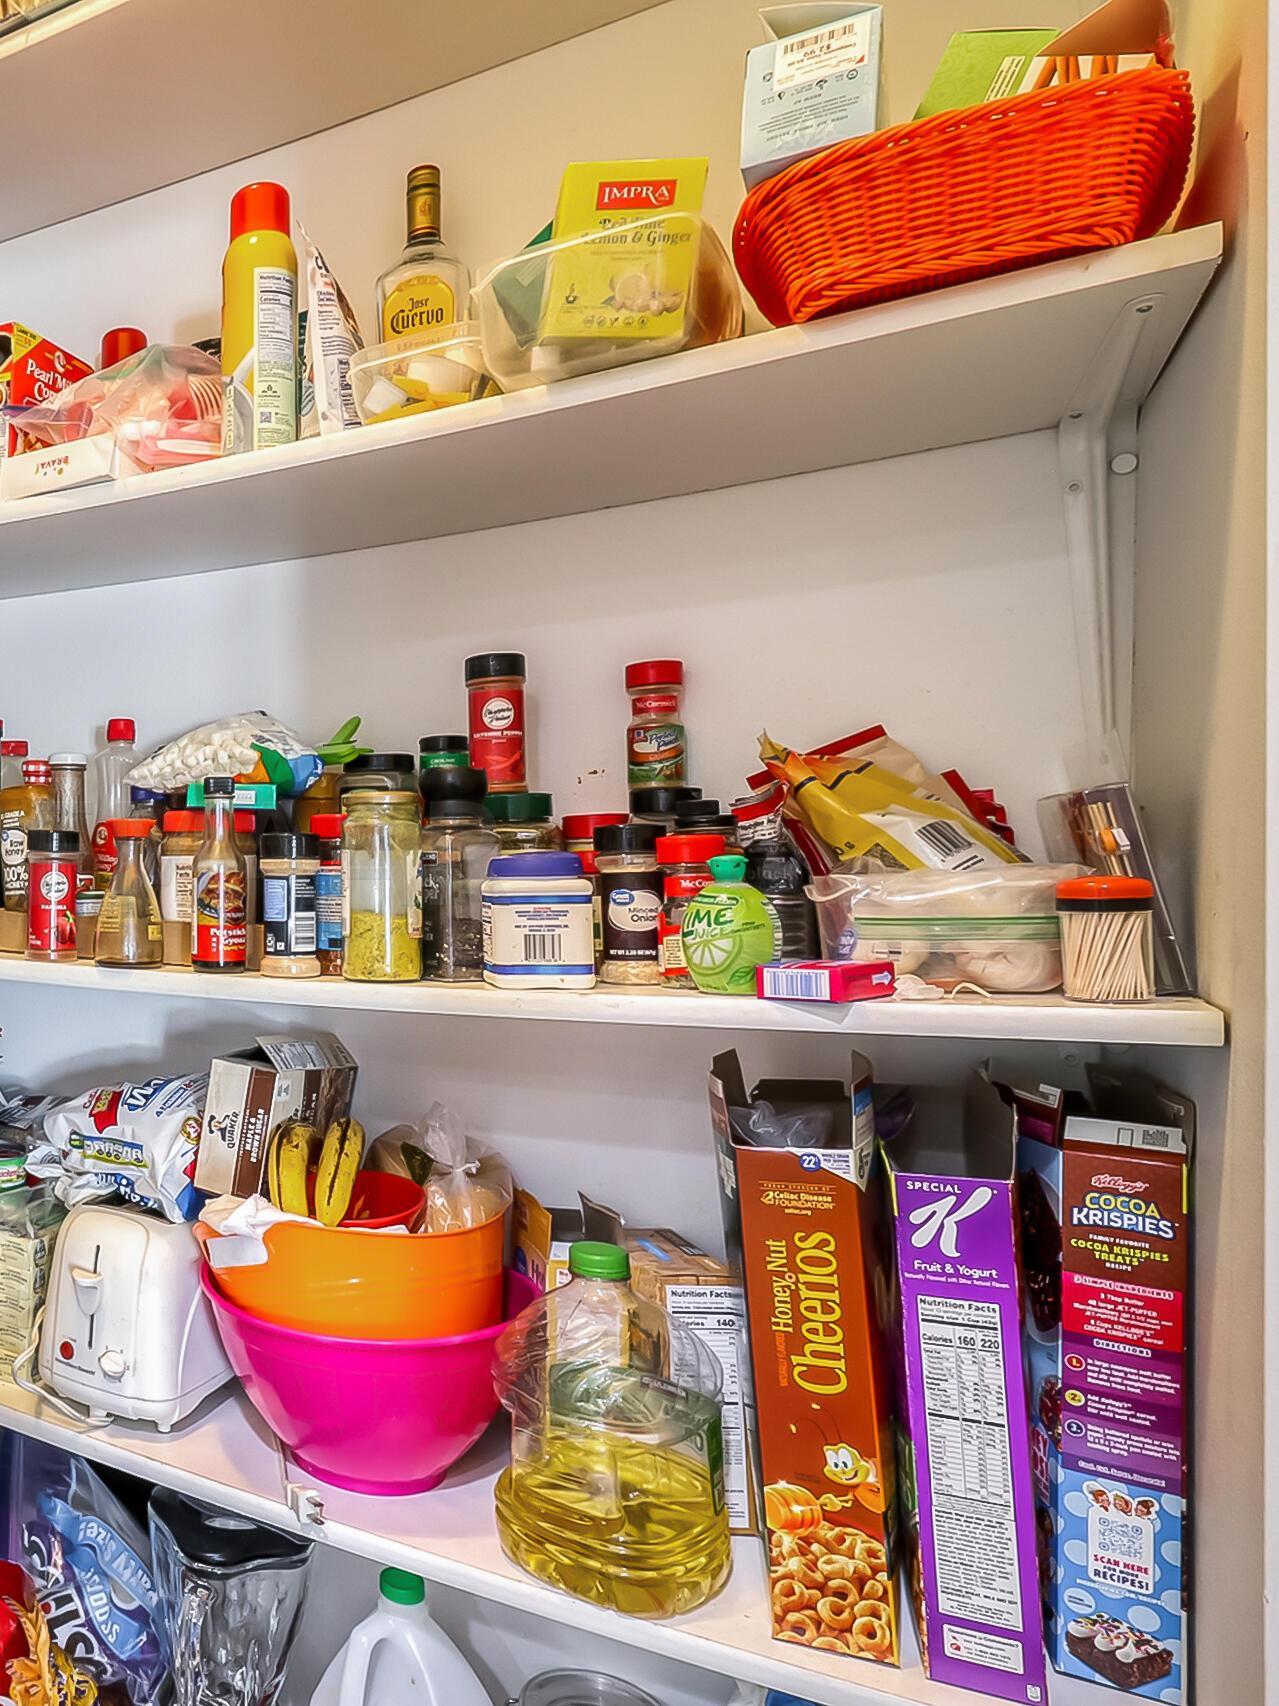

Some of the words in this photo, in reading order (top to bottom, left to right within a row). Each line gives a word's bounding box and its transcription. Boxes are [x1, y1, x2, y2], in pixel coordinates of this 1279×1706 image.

[603, 185, 670, 205] IMPRA
[631, 231, 641, 243] &
[646, 229, 692, 246] Ginger
[390, 307, 444, 334] Cuervo
[26, 358, 53, 383] Pearl
[636, 700, 676, 708] McCormick
[9, 839, 23, 849] Raw
[680, 879, 714, 888] McCor
[628, 906, 658, 915] Minced
[691, 927, 726, 940] JUICE
[226, 1110, 241, 1150] QUAKER
[244, 1125, 256, 1151] MAPLE
[250, 1138, 261, 1163] BROWN
[256, 1109, 266, 1139] SUGAR
[906, 1180, 962, 1194] SPECIAL
[1091, 1173, 1148, 1193] Kellogg's
[774, 1191, 799, 1200] Celiac
[800, 1192, 832, 1202] Disease
[774, 1200, 834, 1210] FOUNDATION
[1085, 1193, 1161, 1219] COCOA
[909, 1186, 993, 1258] K
[1072, 1207, 1175, 1239] KRISPIES
[1070, 1238, 1109, 1252] COCOA
[1113, 1246, 1169, 1262] KRISPIES
[1088, 1233, 1114, 1243] FAMILY
[1116, 1237, 1150, 1249] FAVORITE
[765, 1238, 787, 1273] Nut
[1094, 1251, 1139, 1265] TREATS
[914, 1260, 942, 1273] Fruit
[945, 1263, 955, 1275] &
[956, 1264, 999, 1279] Yogurt
[1105, 1262, 1132, 1271] RECIPE
[671, 1289, 707, 1299] Nutrition
[709, 1290, 732, 1299] Facts
[1114, 1282, 1174, 1300] INGREDIENTS
[771, 1278, 794, 1334] Honey
[792, 1231, 848, 1396] Cheerios
[919, 1297, 965, 1311] Nutrition
[968, 1303, 997, 1314] Facts
[716, 1318, 735, 1328] 140
[921, 1333, 953, 1344] Calories
[957, 1334, 976, 1347] 160
[980, 1337, 999, 1349] 220
[1094, 1338, 1151, 1357] DIRECTIONS
[1093, 1554, 1121, 1567] SCAN
[1123, 1562, 1150, 1576] HERE
[1103, 1565, 1117, 1573] FOR
[1119, 1568, 1139, 1579] MORE
[1093, 1568, 1150, 1592] RECIPES!
